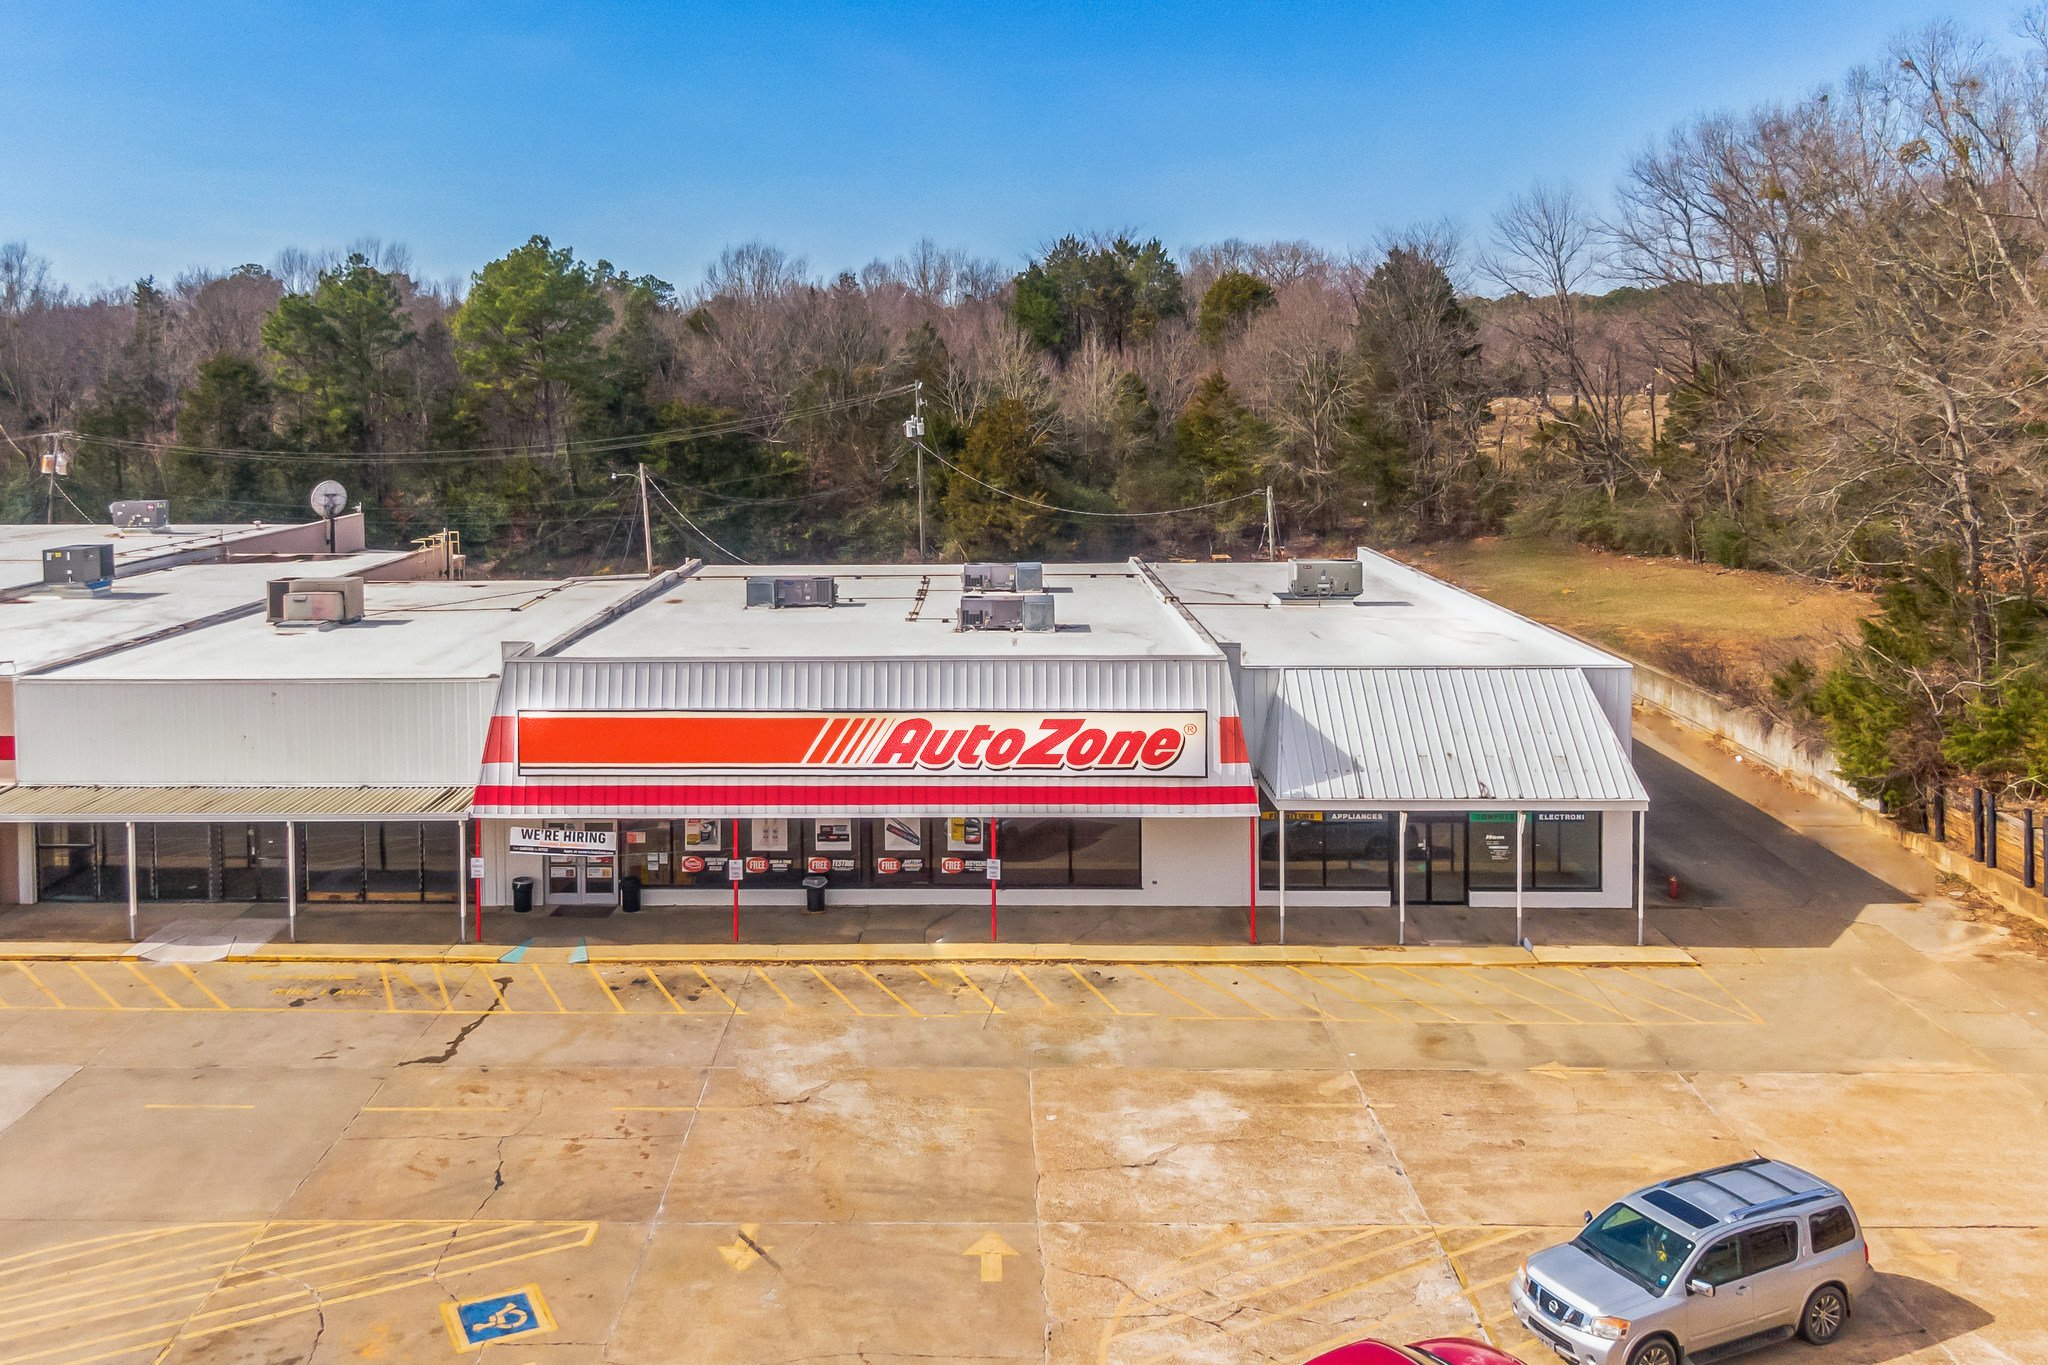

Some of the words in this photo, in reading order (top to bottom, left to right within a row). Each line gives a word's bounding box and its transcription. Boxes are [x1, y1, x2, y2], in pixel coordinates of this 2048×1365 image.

[872, 718, 1185, 768] AutoZone
[521, 828, 560, 841] WE'RE
[563, 831, 606, 844] HIRING
[749, 861, 765, 870] FREE
[812, 861, 827, 870] FREE
[832, 859, 854, 867] TESTING
[881, 861, 897, 870] FREE
[945, 861, 961, 870] FREE
